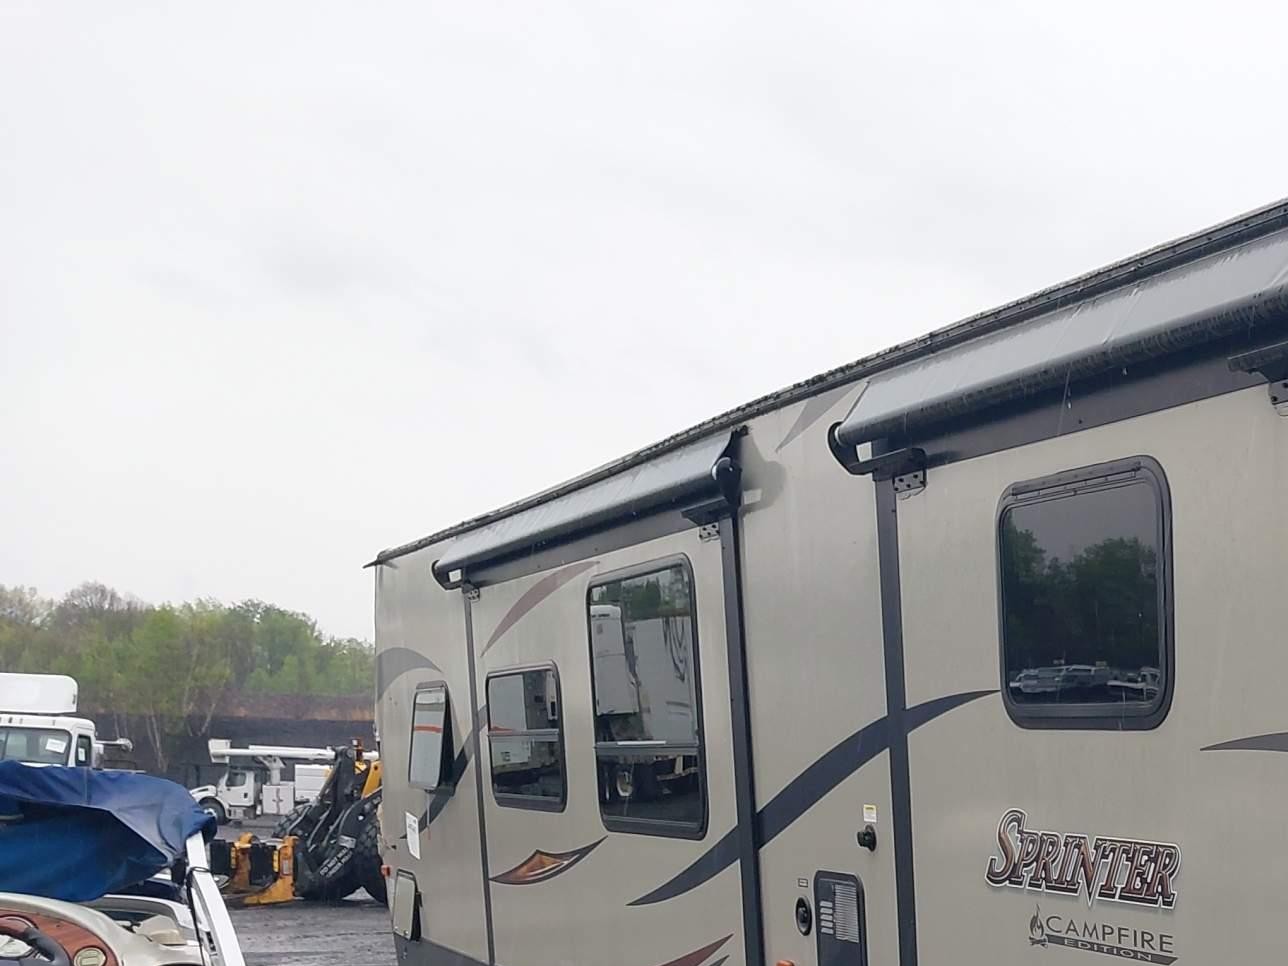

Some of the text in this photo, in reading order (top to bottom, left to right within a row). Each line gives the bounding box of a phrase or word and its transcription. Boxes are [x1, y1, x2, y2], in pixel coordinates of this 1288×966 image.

[985, 808, 1181, 909] SPRINTER
[1045, 915, 1174, 954] CAMPFIRE
[1063, 938, 1152, 962] EDITION
